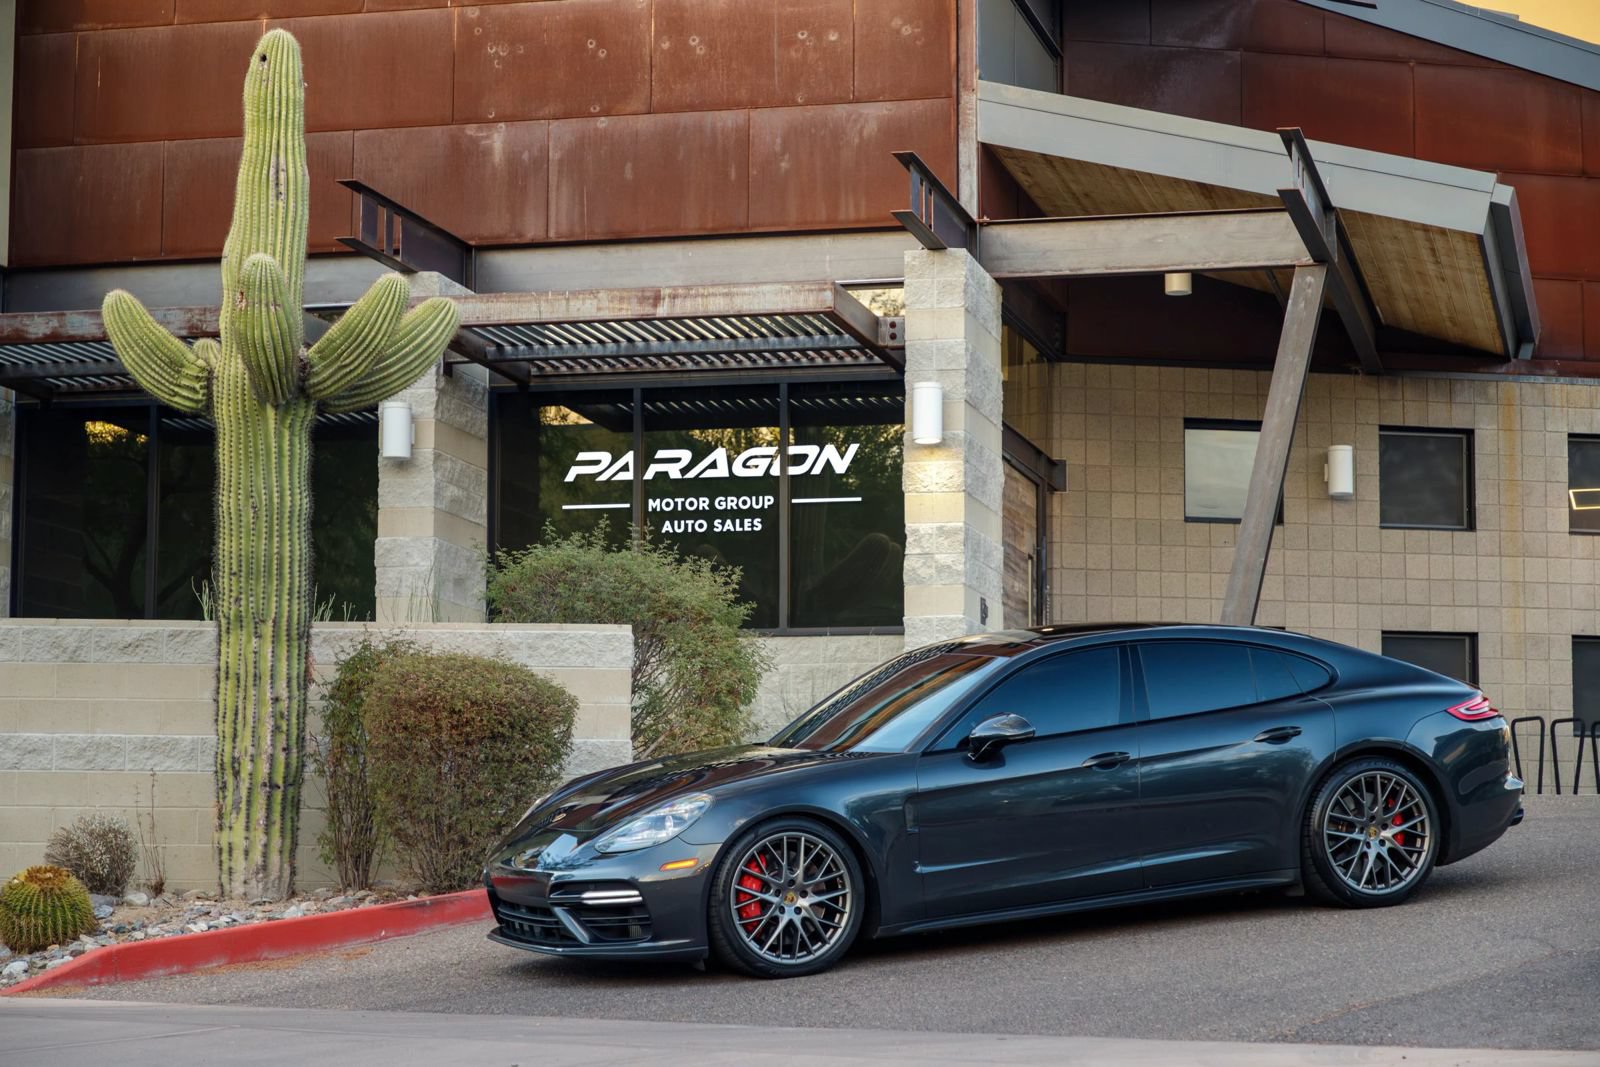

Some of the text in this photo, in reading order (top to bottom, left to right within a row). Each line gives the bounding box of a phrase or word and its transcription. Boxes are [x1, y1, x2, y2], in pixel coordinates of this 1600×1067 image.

[563, 443, 860, 482] PARAGON
[648, 495, 775, 512] MOTOR GROUP
[661, 517, 763, 534] AUTO SALES
